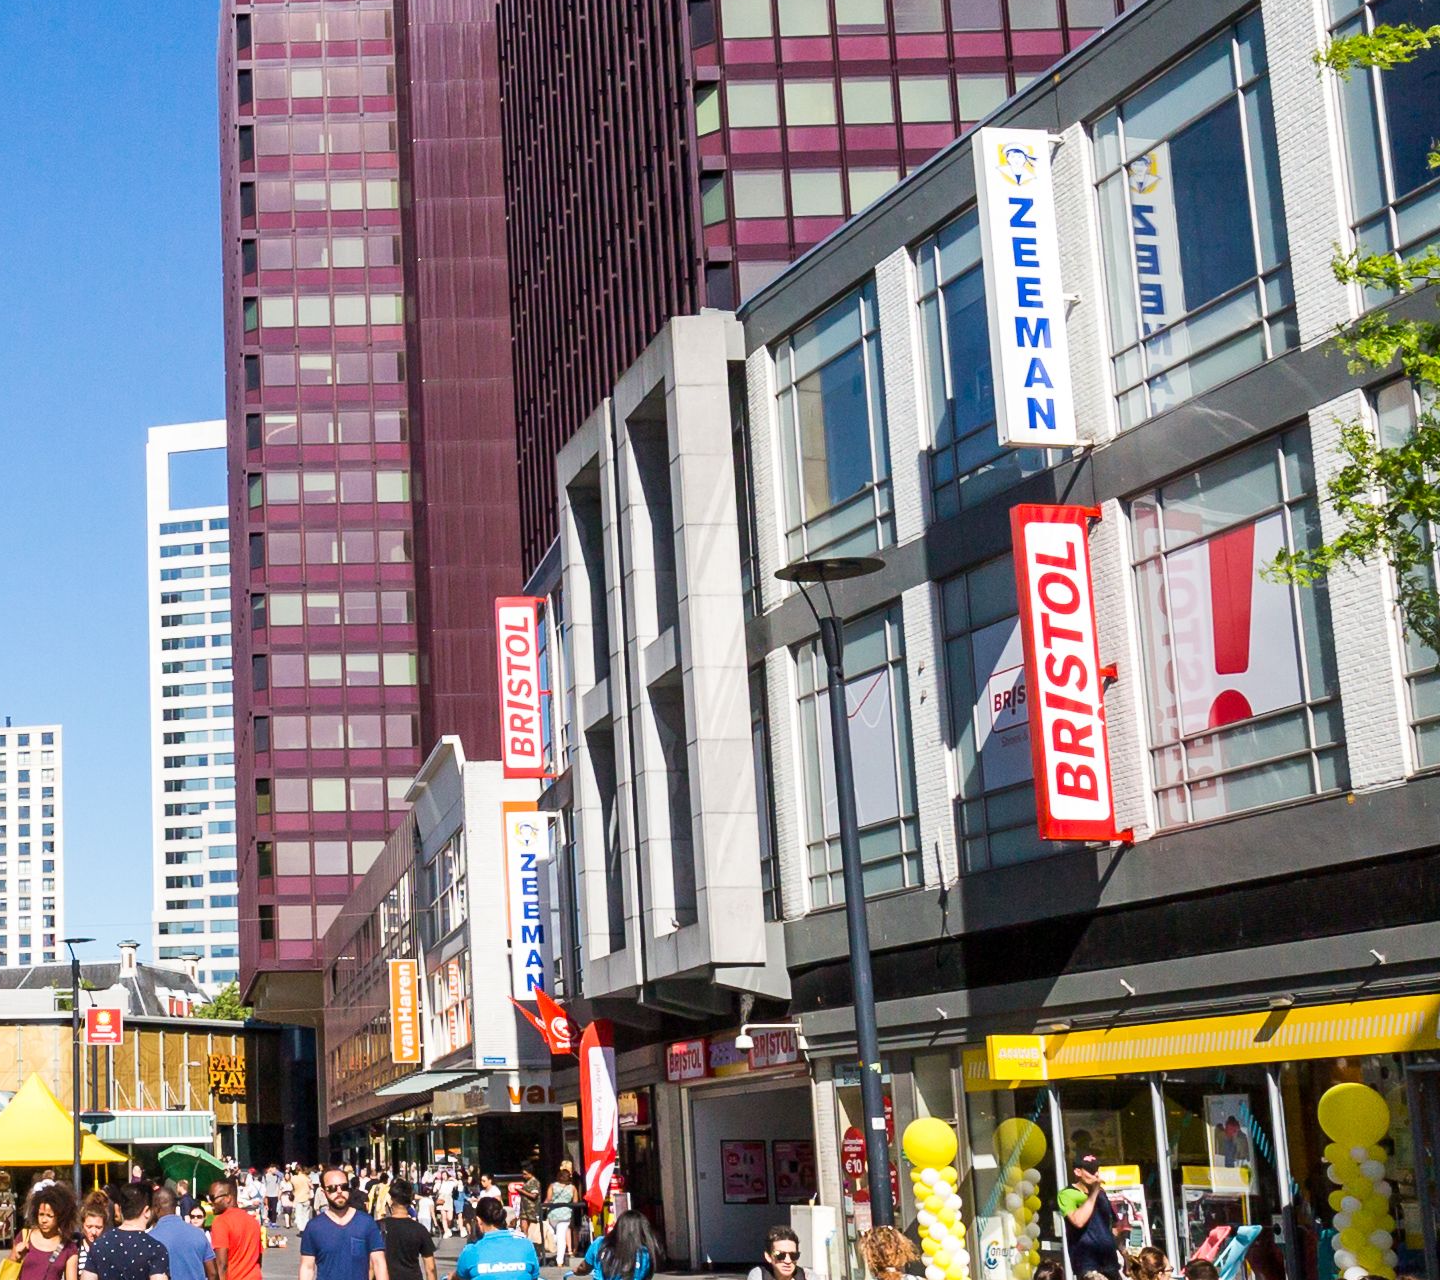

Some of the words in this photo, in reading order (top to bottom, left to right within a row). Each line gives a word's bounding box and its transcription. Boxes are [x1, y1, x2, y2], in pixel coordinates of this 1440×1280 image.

[1008, 197, 1057, 430] ZEEMAN
[504, 616, 536, 757] BRISTOL
[994, 684, 1026, 716] BRIS
[1034, 539, 1102, 803] BRISTOL
[520, 853, 545, 992] ZEEMAN
[397, 963, 414, 1058] vanHaren
[753, 1030, 795, 1062] BRISTOL
[670, 1046, 702, 1072] BRISTOL
[845, 1158, 863, 1174] €10
